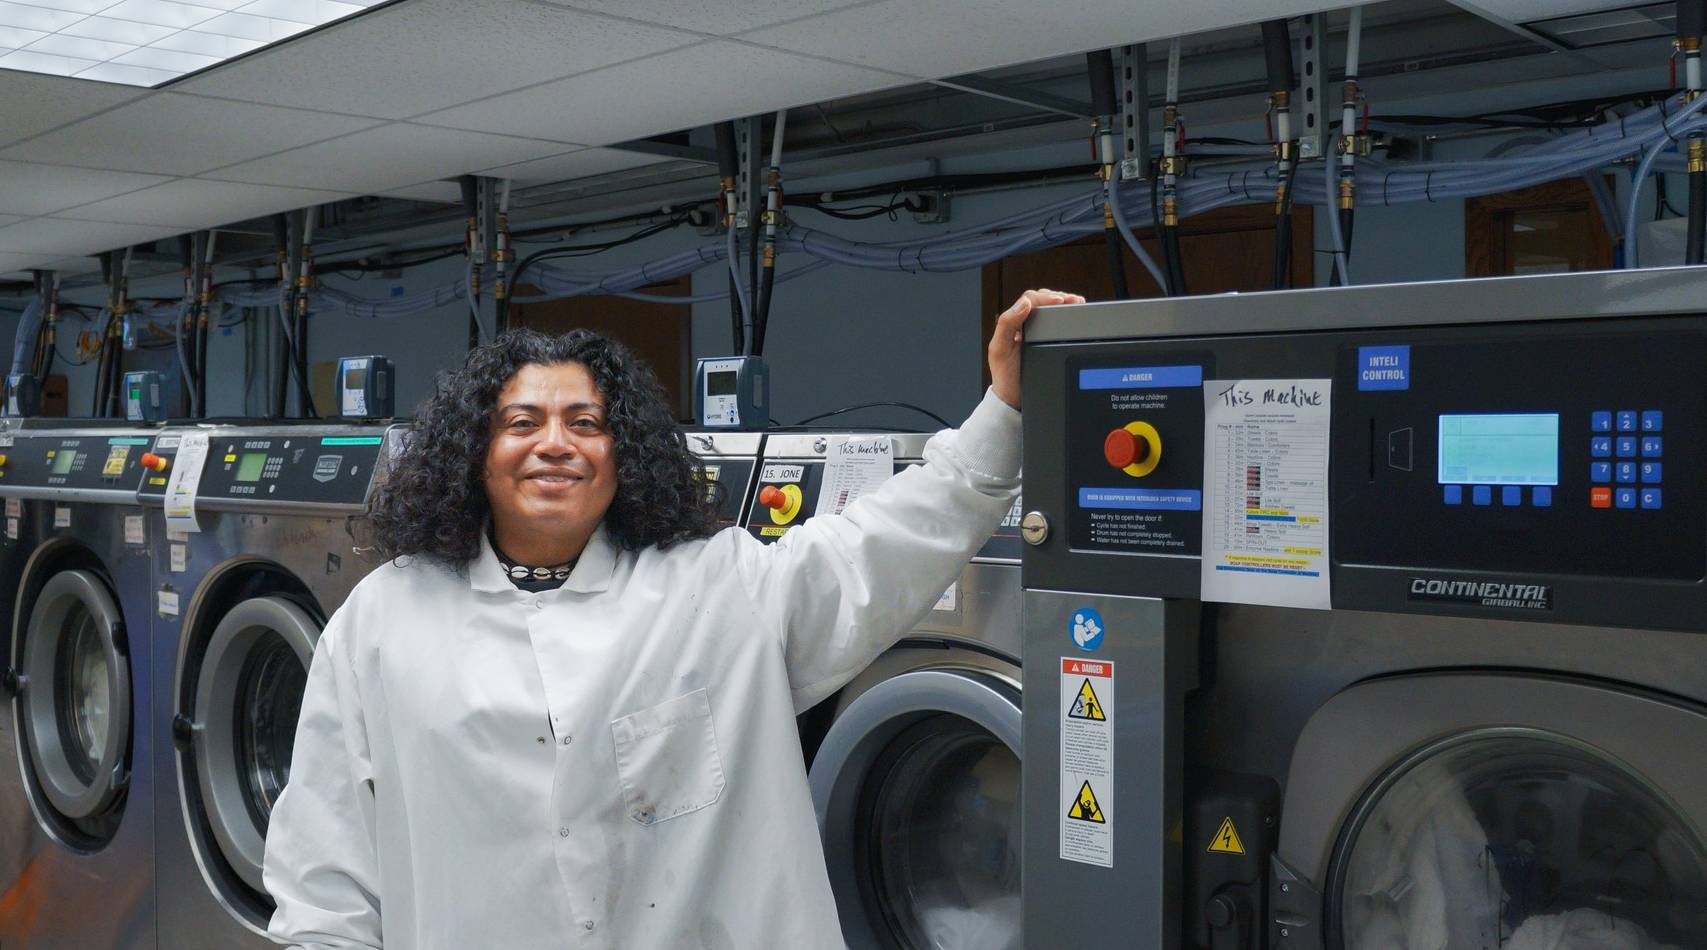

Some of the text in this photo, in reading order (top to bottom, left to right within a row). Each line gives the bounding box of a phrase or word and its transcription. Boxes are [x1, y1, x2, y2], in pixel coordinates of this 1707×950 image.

[1369, 356, 1398, 366] INTELI
[1362, 370, 1406, 380] CONTROL
[1219, 384, 1254, 407] This
[1602, 420, 1608, 429] 1
[1623, 420, 1631, 429] 2
[1645, 420, 1652, 429] 3
[1600, 443, 1608, 451] 4
[1624, 443, 1630, 451] 5
[1644, 443, 1652, 451] 6
[1601, 464, 1608, 472] 7
[1623, 464, 1630, 473] 8
[1644, 464, 1652, 474] 9
[780, 470, 800, 478] JONE
[1622, 494, 1630, 502] 0
[1644, 494, 1652, 502] C
[1411, 580, 1547, 600] CONTINENTAL
[1082, 664, 1103, 674] DANGER
